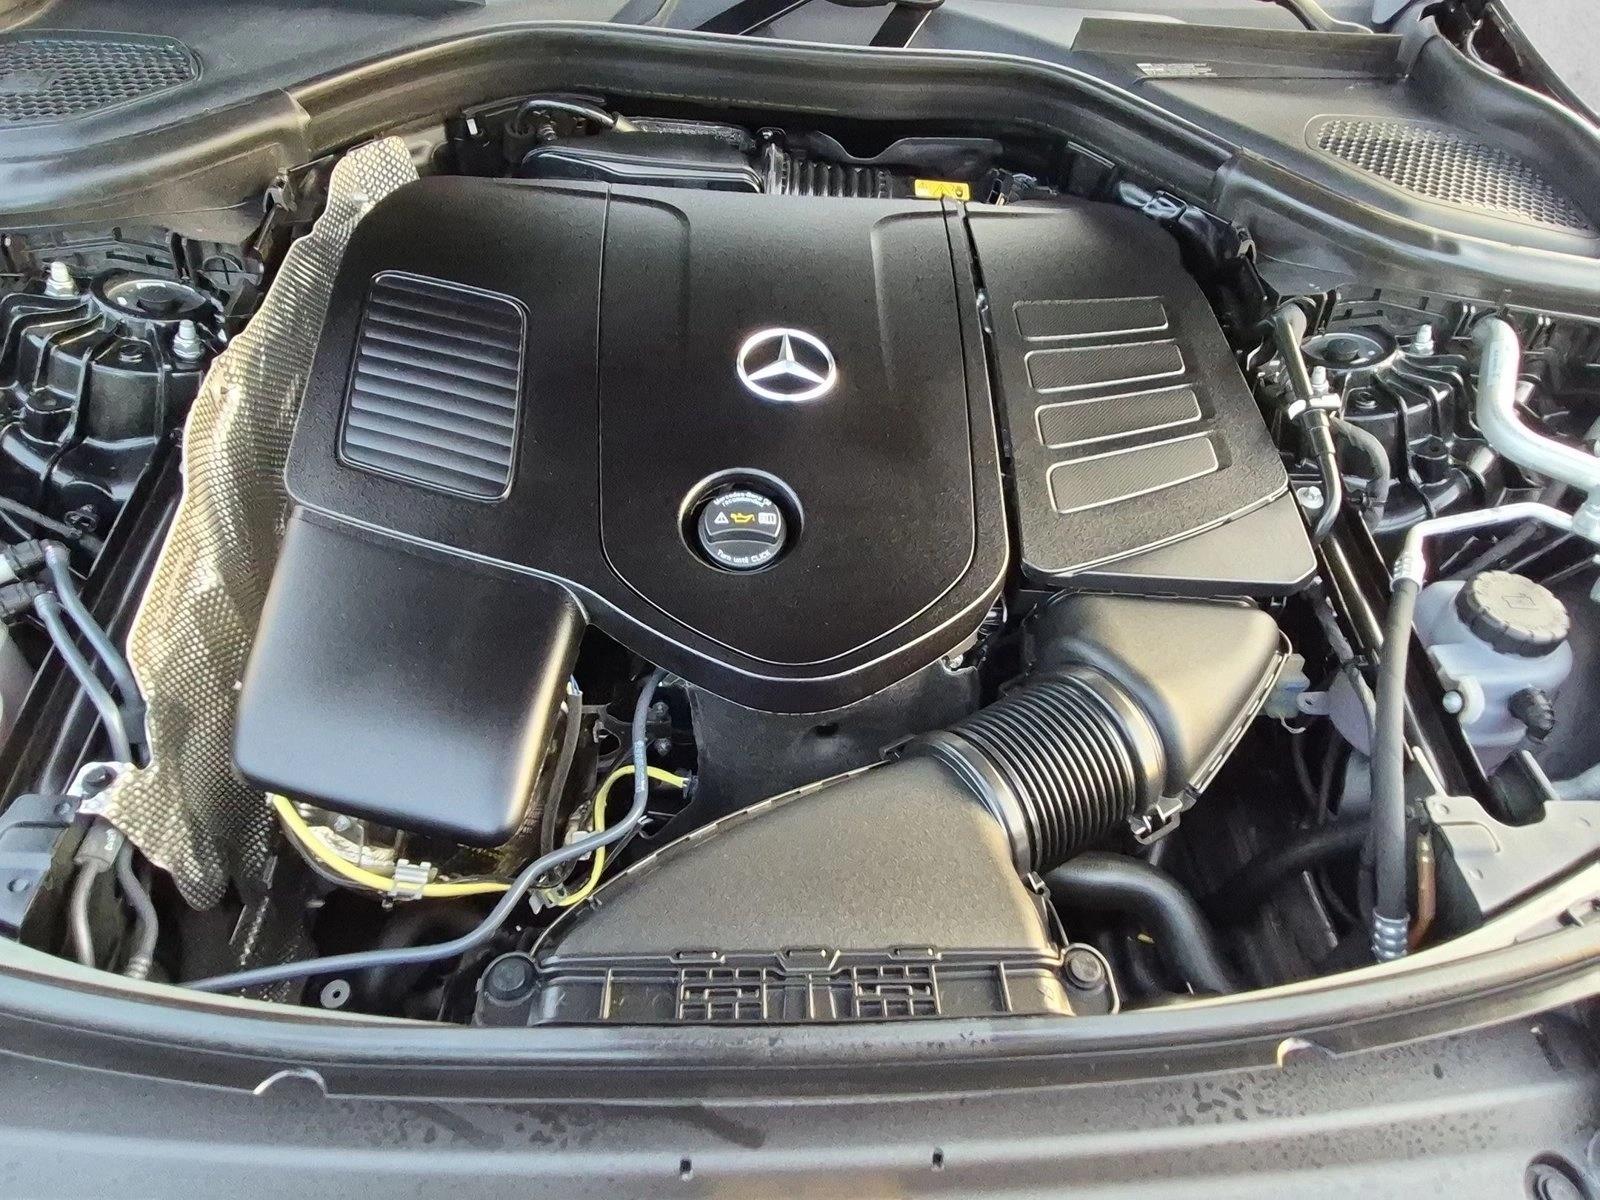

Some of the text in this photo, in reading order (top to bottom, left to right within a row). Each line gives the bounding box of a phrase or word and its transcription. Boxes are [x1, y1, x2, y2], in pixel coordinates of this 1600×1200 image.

[713, 492, 763, 505] Mercedes-Benz
[717, 549, 731, 561] Turn
[750, 550, 772, 562] CLICK
